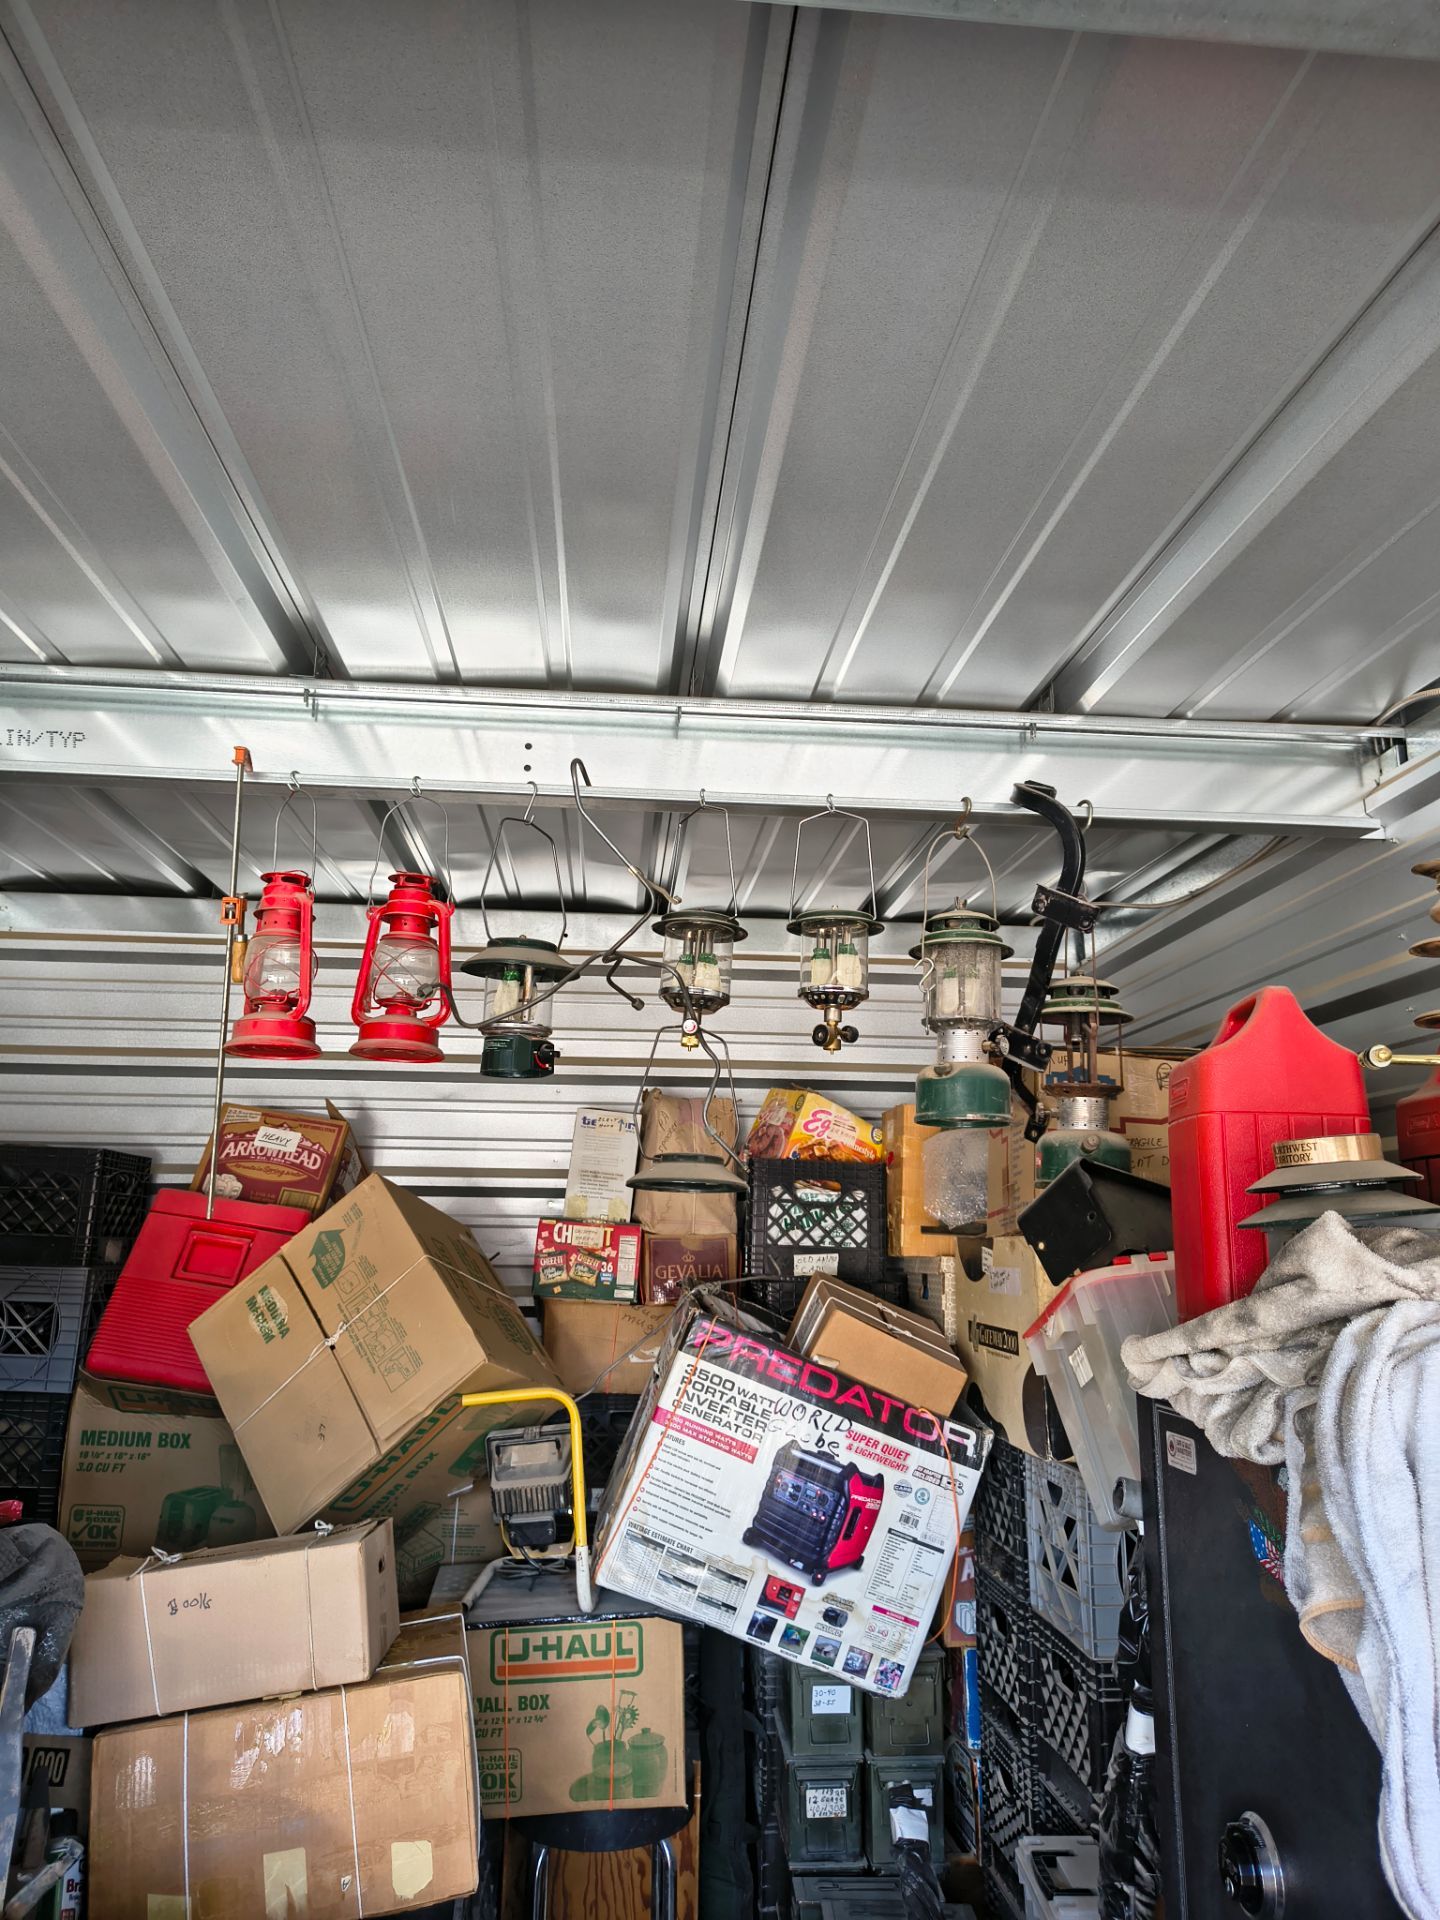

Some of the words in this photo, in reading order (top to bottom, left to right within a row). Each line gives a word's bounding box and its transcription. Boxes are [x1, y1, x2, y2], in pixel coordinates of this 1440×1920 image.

[0, 729, 87, 748] IN/TYP
[261, 1131, 294, 1148] HEAVY
[219, 1141, 322, 1170] ARROWHEAD
[600, 1261, 613, 1273] 36
[655, 1264, 723, 1279] GEVALIA
[684, 1363, 735, 1392] 3500
[737, 1386, 776, 1410] WATT
[694, 1321, 977, 1457] PREDATOR
[680, 1375, 772, 1420] PORTABLE
[672, 1399, 763, 1444] GENERATOR
[775, 1397, 852, 1433] WORLD
[80, 1430, 152, 1448] MEDIUM
[157, 1432, 192, 1449] BOX
[660, 1431, 685, 1446] FATURES
[845, 1429, 882, 1449] SUPER
[881, 1443, 911, 1462] QUIET
[95, 1463, 109, 1473] CU
[112, 1463, 126, 1473] FT
[854, 1445, 909, 1474] LIGHTWEIGHT!
[87, 1525, 117, 1539] OK
[676, 1542, 694, 1554] CHART
[501, 1631, 634, 1662] U-HAUL
[476, 1696, 512, 1712] ALL
[518, 1694, 550, 1711] BOX
[490, 1728, 503, 1738] FT
[481, 1772, 516, 1790] OK
